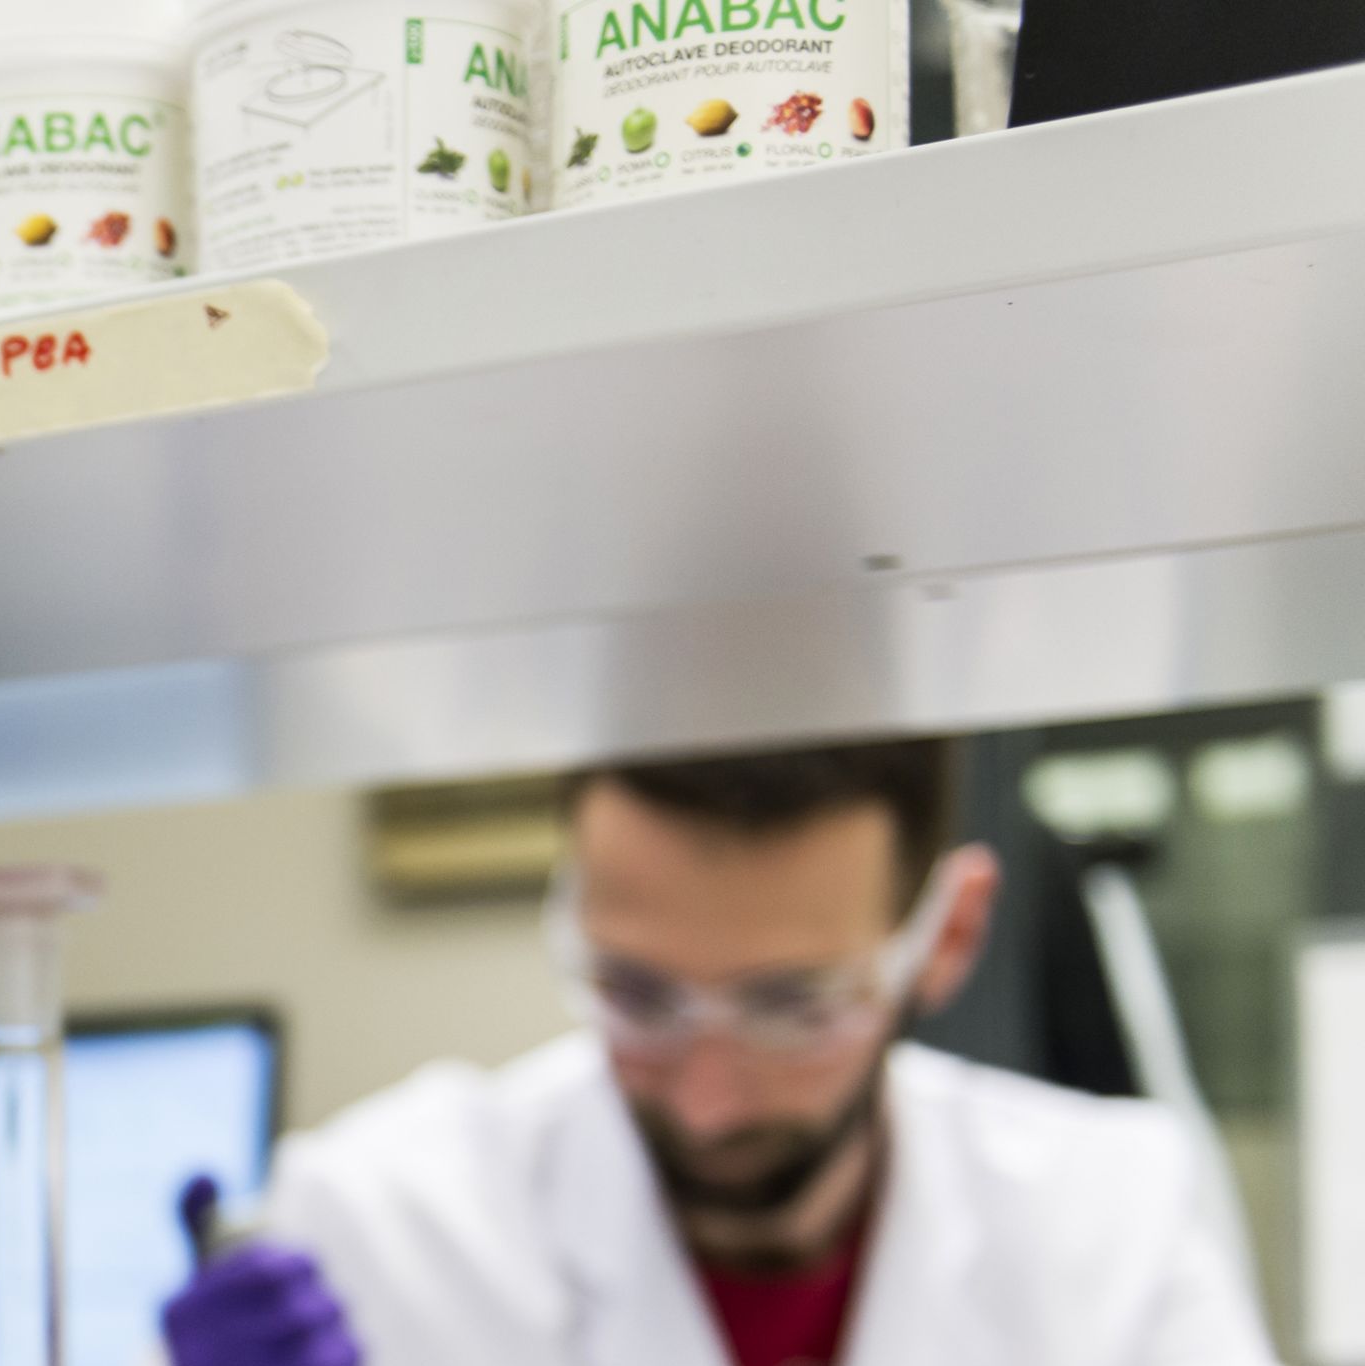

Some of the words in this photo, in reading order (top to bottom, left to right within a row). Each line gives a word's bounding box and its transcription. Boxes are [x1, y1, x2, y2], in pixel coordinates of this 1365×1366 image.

[596, 0, 847, 58] ANABAC
[604, 44, 707, 78] AUTOCLAVE
[714, 39, 833, 56] DEODORANT
[694, 63, 740, 79] POUR
[744, 60, 833, 75] AUTOCLAVE
